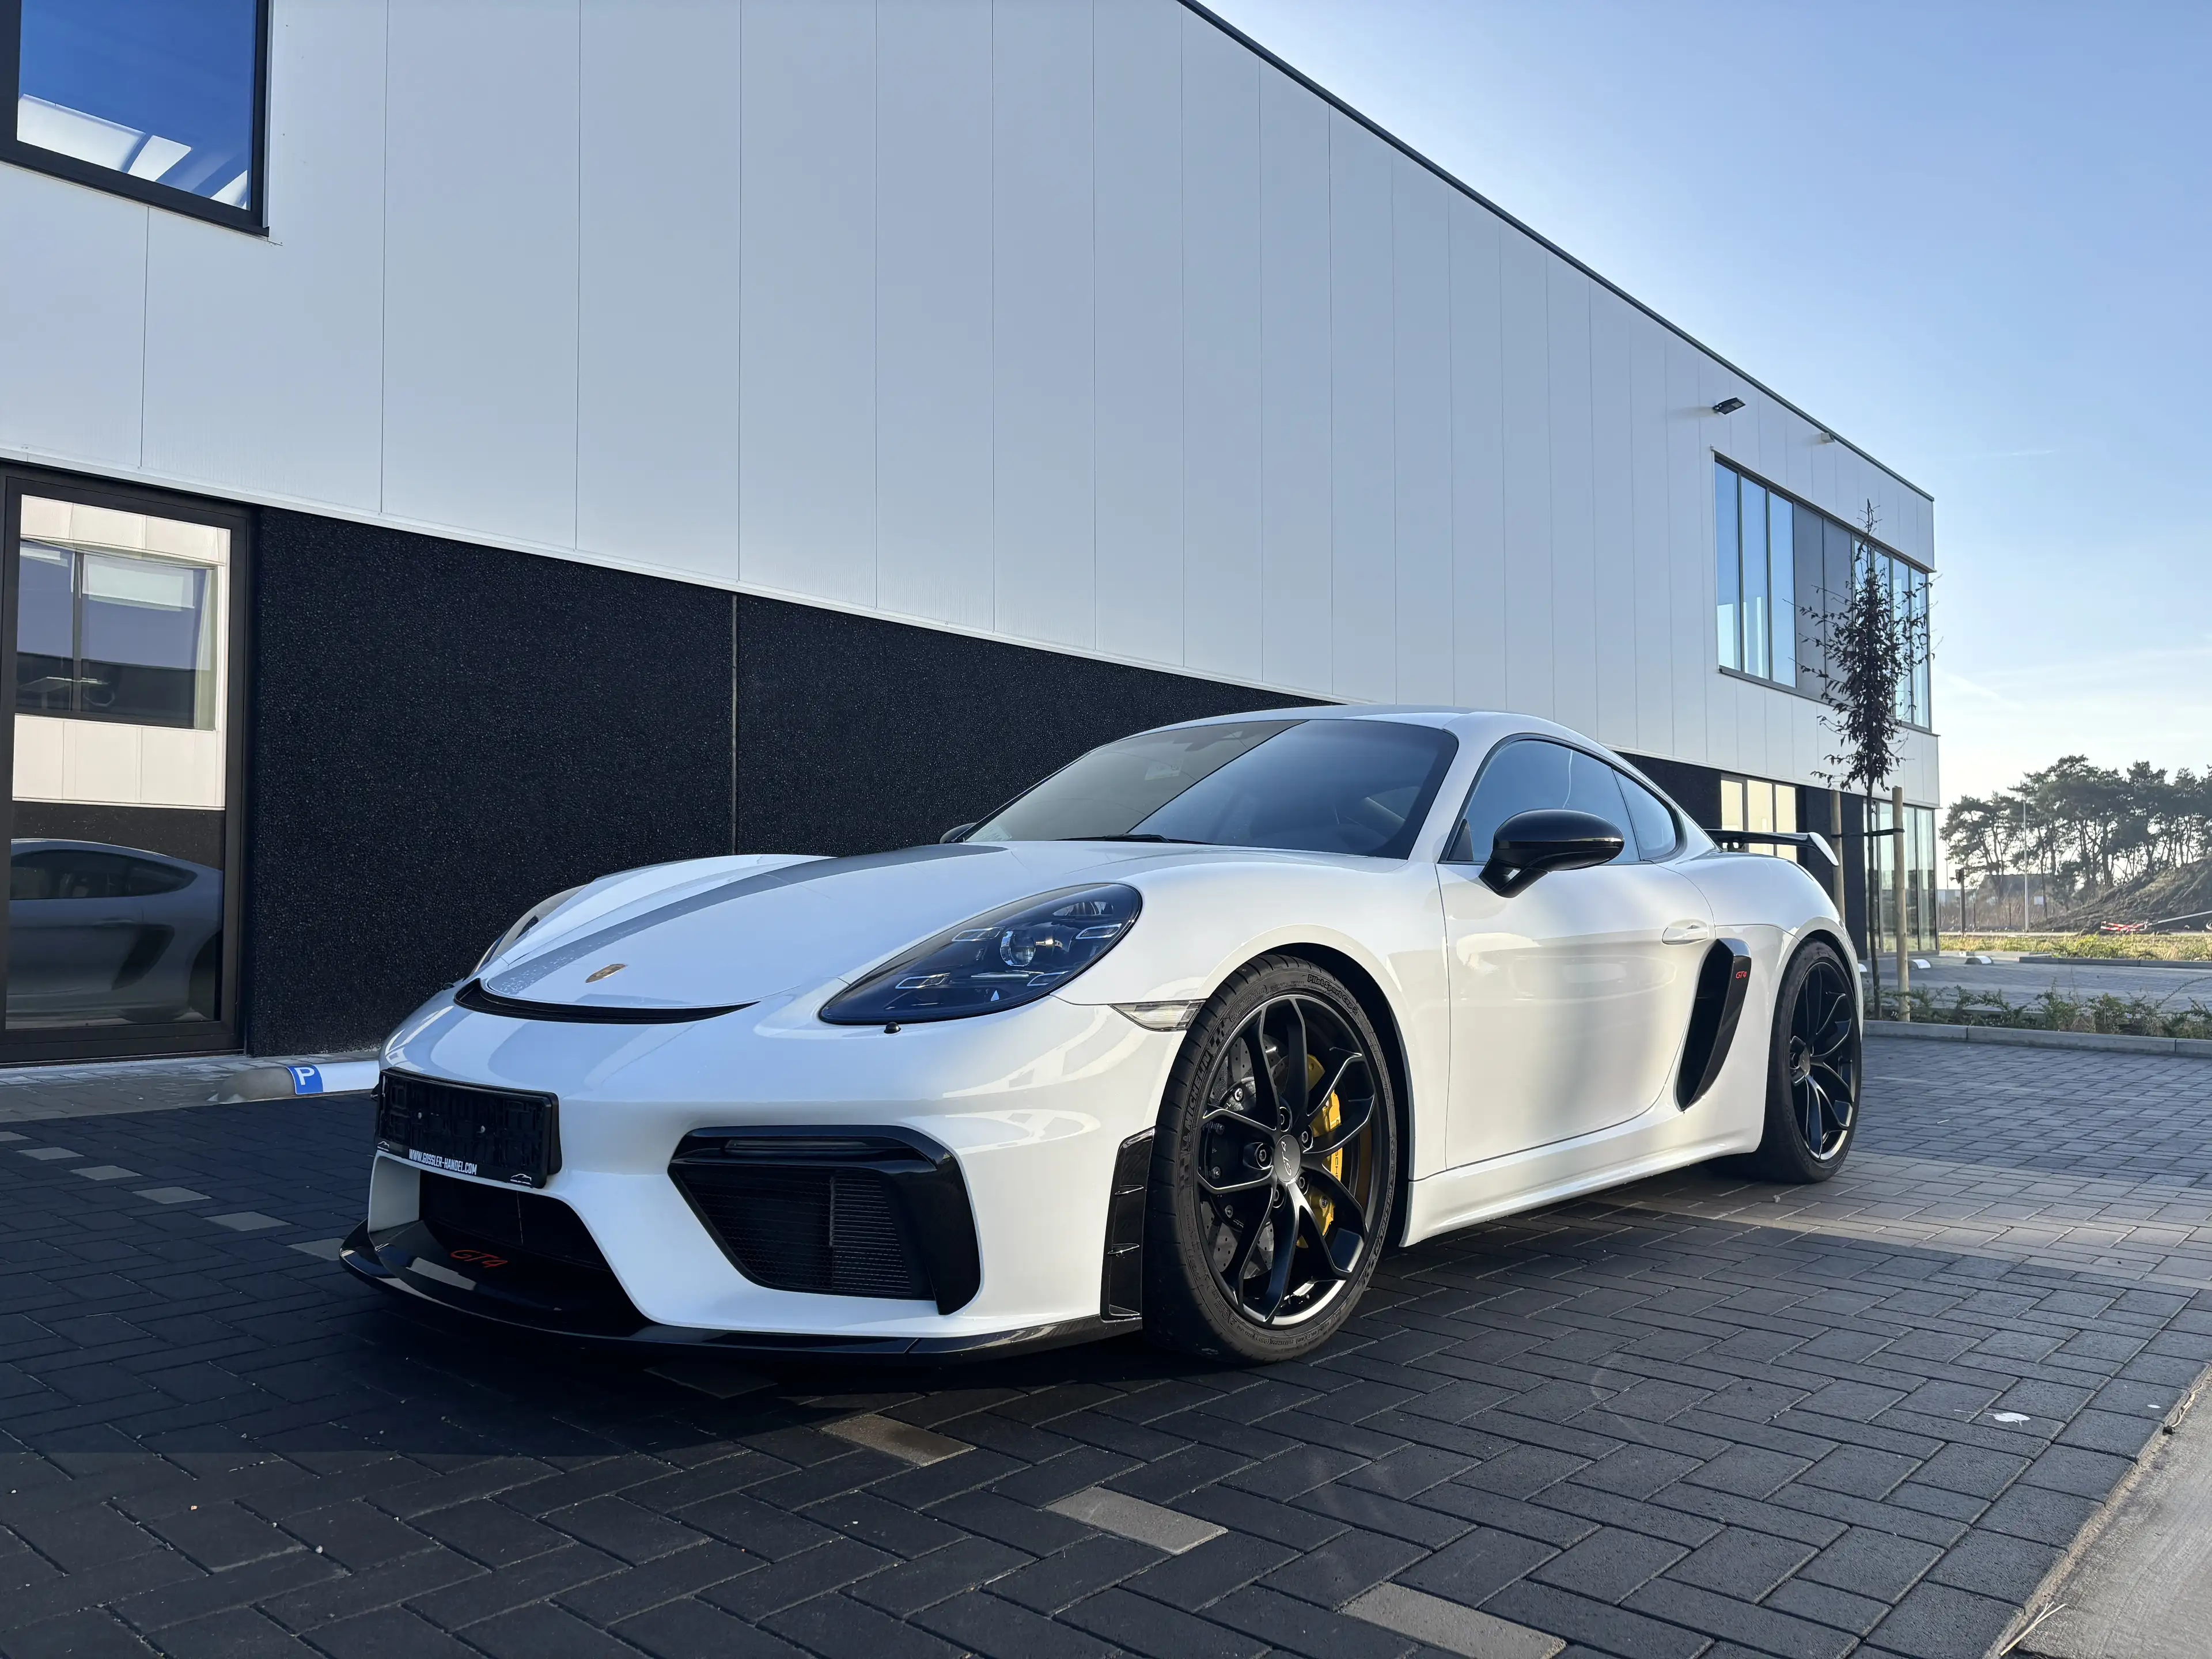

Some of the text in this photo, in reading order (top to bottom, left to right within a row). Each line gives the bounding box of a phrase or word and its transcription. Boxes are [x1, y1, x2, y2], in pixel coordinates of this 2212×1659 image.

[1736, 971, 1747, 979] GT4
[294, 1067, 315, 1085] P
[1184, 1049, 1211, 1131] MICHELIN
[408, 1148, 478, 1175] WWW.GOSSLER-HANDEL.COM
[1281, 1141, 1292, 1176] GT4
[450, 1249, 508, 1268] GT4
